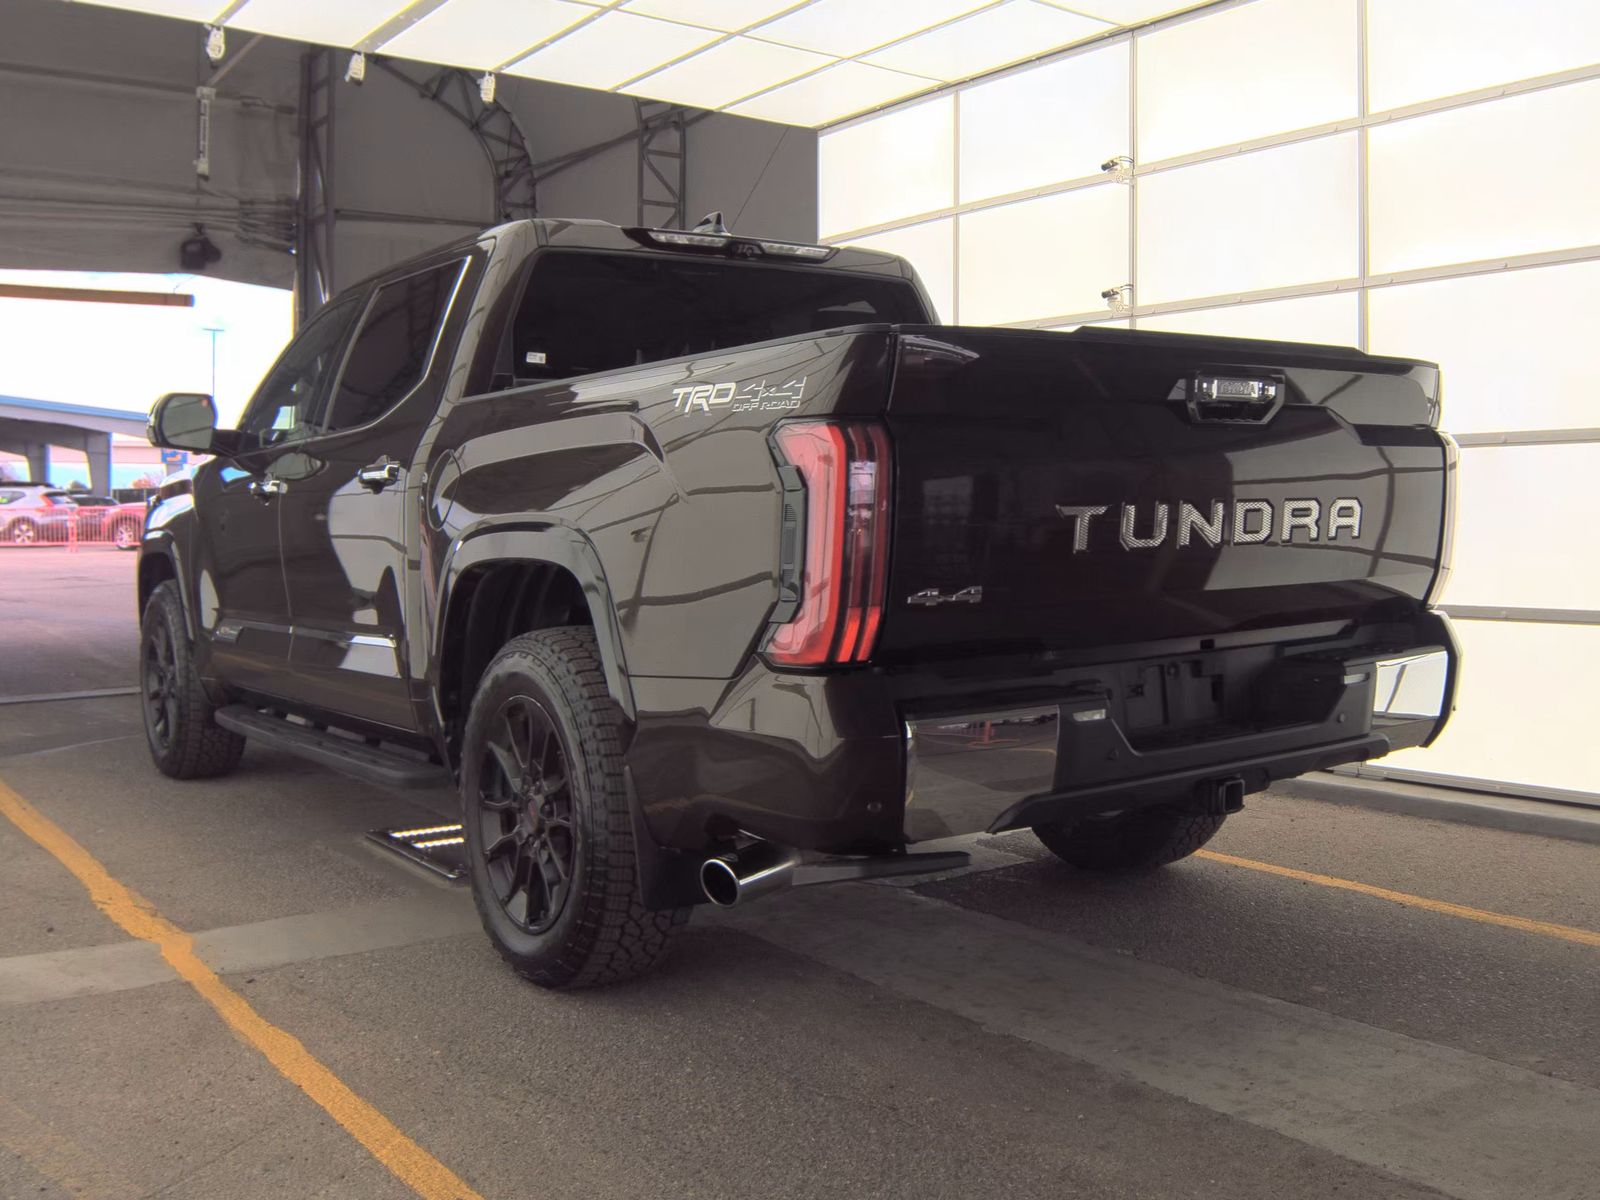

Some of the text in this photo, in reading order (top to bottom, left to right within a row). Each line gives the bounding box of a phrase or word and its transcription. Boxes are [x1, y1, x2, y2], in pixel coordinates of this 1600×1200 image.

[672, 382, 736, 413] TRD
[732, 400, 800, 412] OFF ROAD
[1055, 498, 1362, 554] TUNDRA
